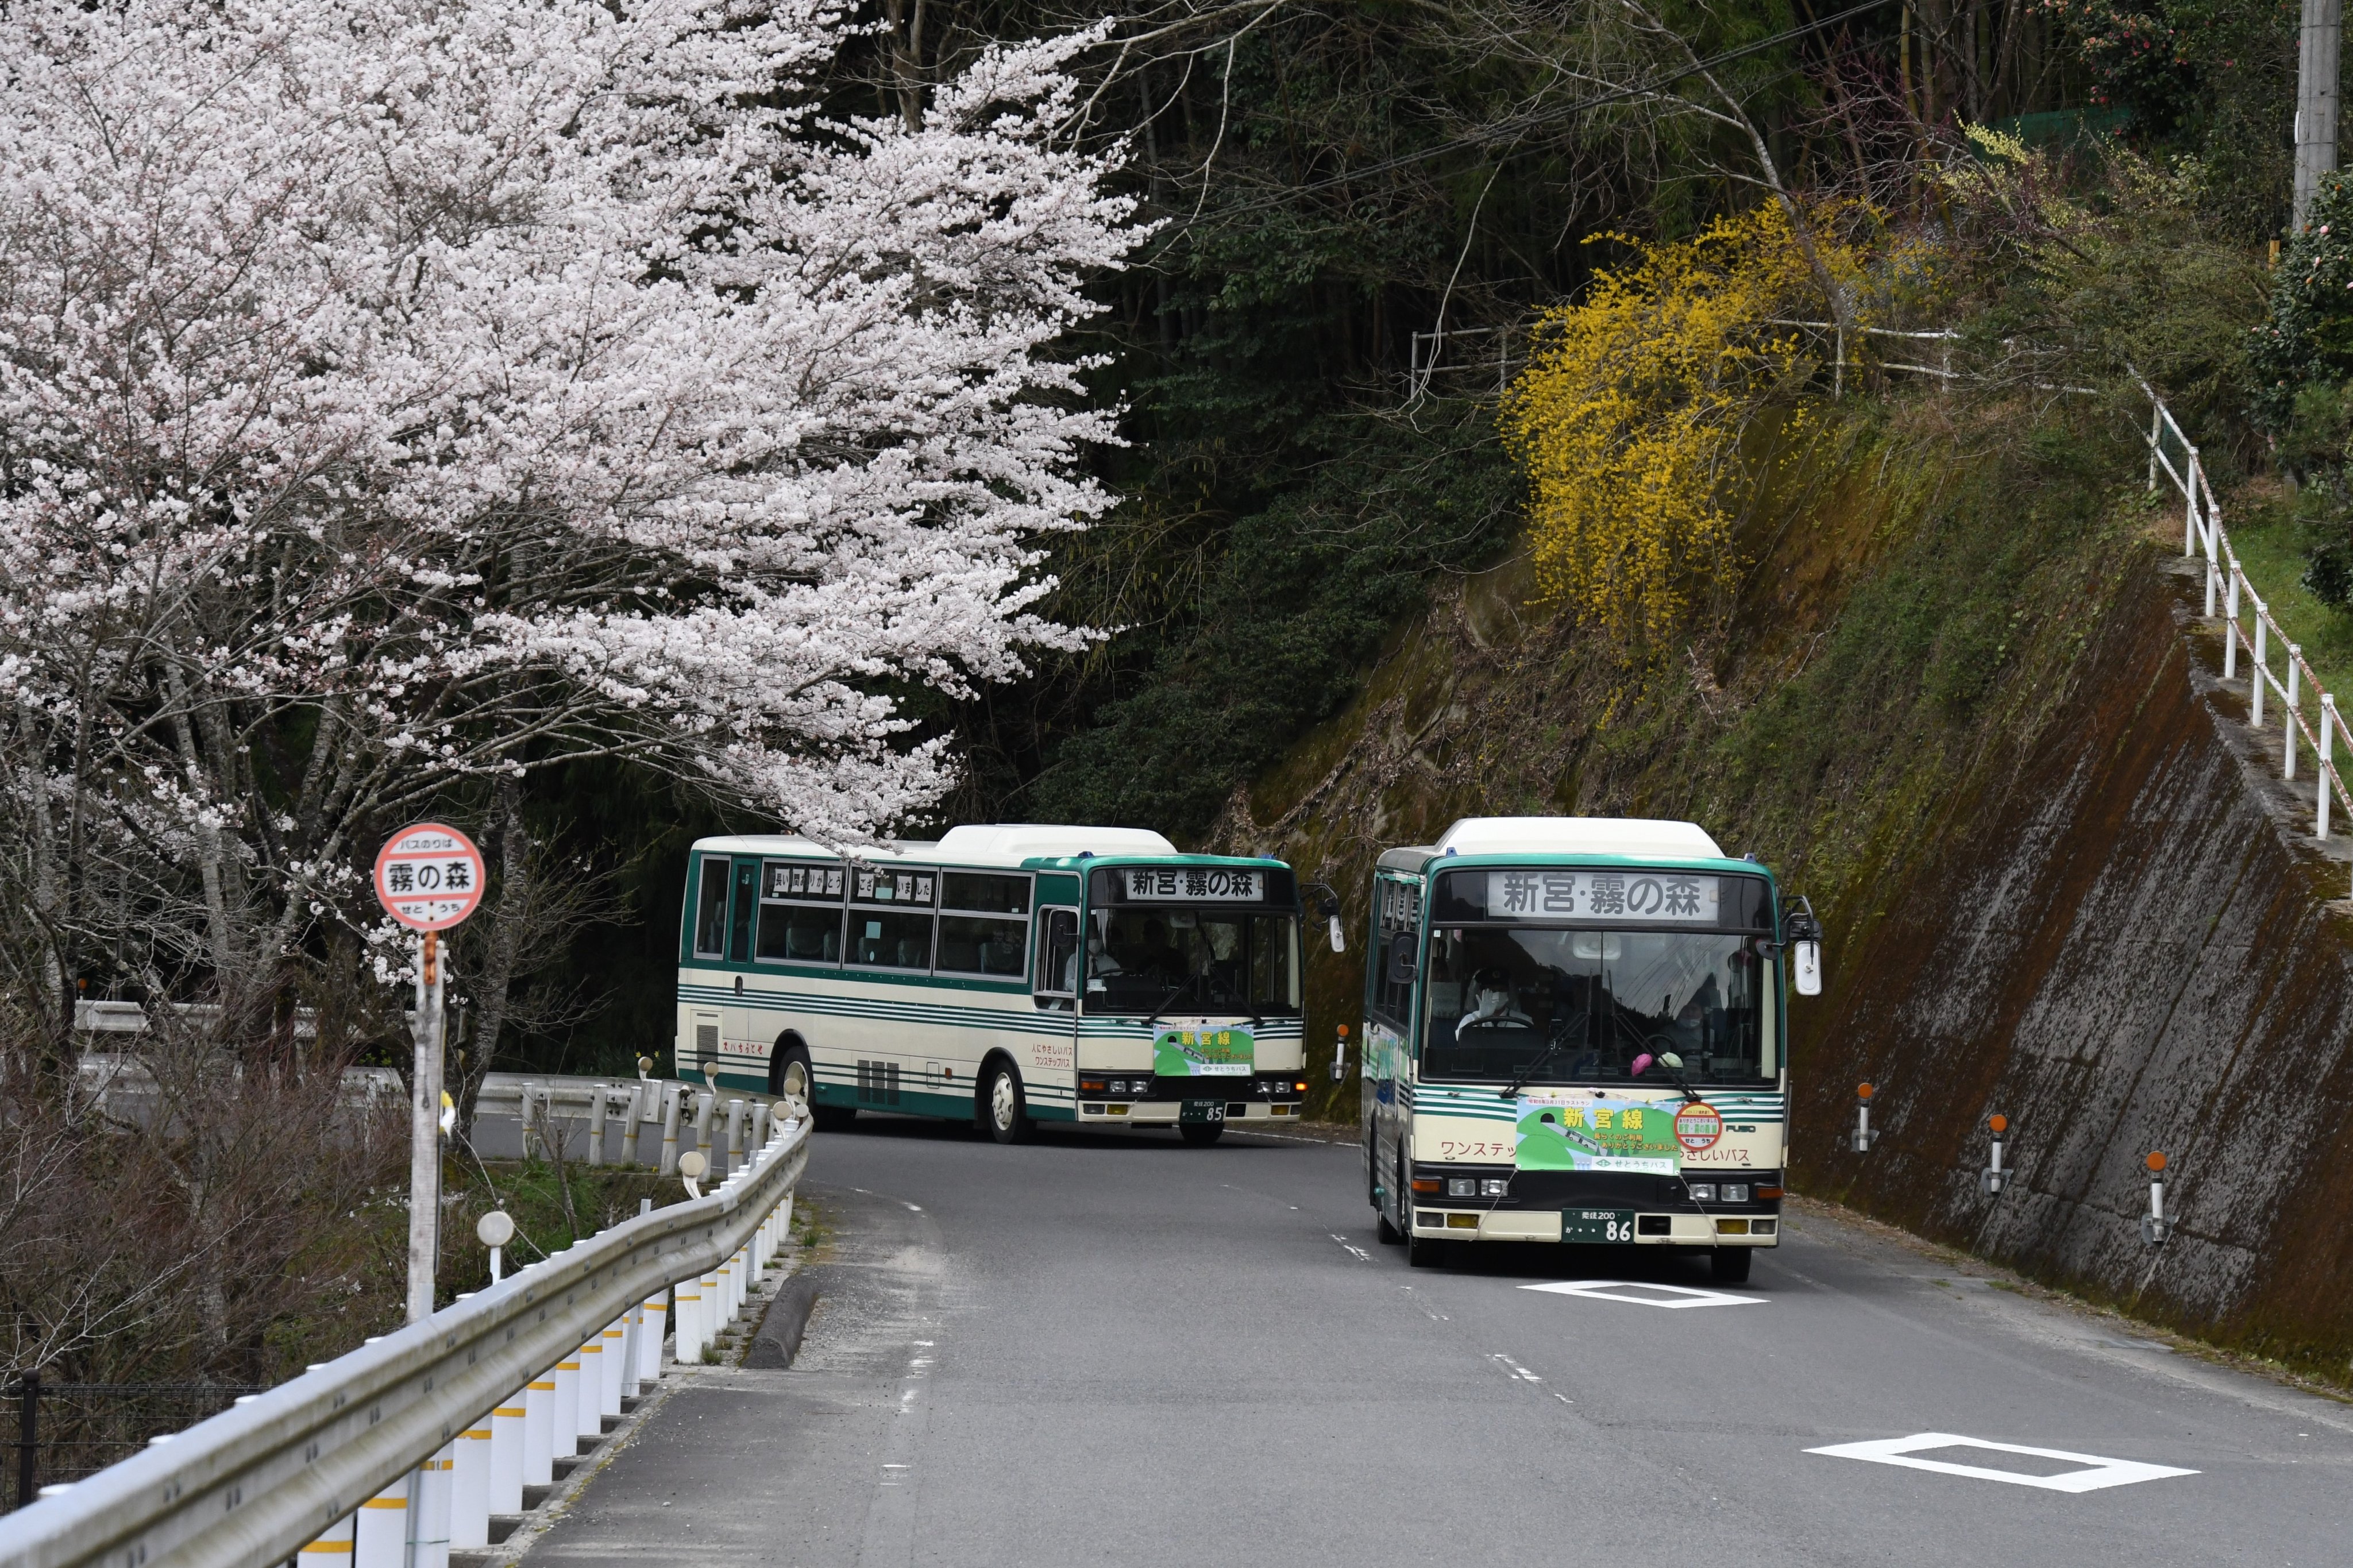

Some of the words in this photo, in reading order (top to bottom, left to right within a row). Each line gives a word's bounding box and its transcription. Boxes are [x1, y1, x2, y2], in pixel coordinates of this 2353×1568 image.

[400, 839, 452, 849] バスのりば
[388, 862, 470, 892] 霧の森
[1133, 869, 1253, 897] 新宮・霧の森
[1504, 872, 1700, 916] 新宮・霧の森
[1182, 1031, 1230, 1045] 新宮線
[1032, 1043, 1073, 1056] 人にやさしいバス
[1035, 1057, 1070, 1068] ワンステップバス
[1563, 1107, 1644, 1130] 新宮線
[1726, 1125, 1756, 1133] FUSO
[1594, 1132, 1643, 1141] 長らくのご利用
[1601, 1141, 1679, 1152] ありがとうございました
[1615, 1160, 1667, 1169] せとうちバス
